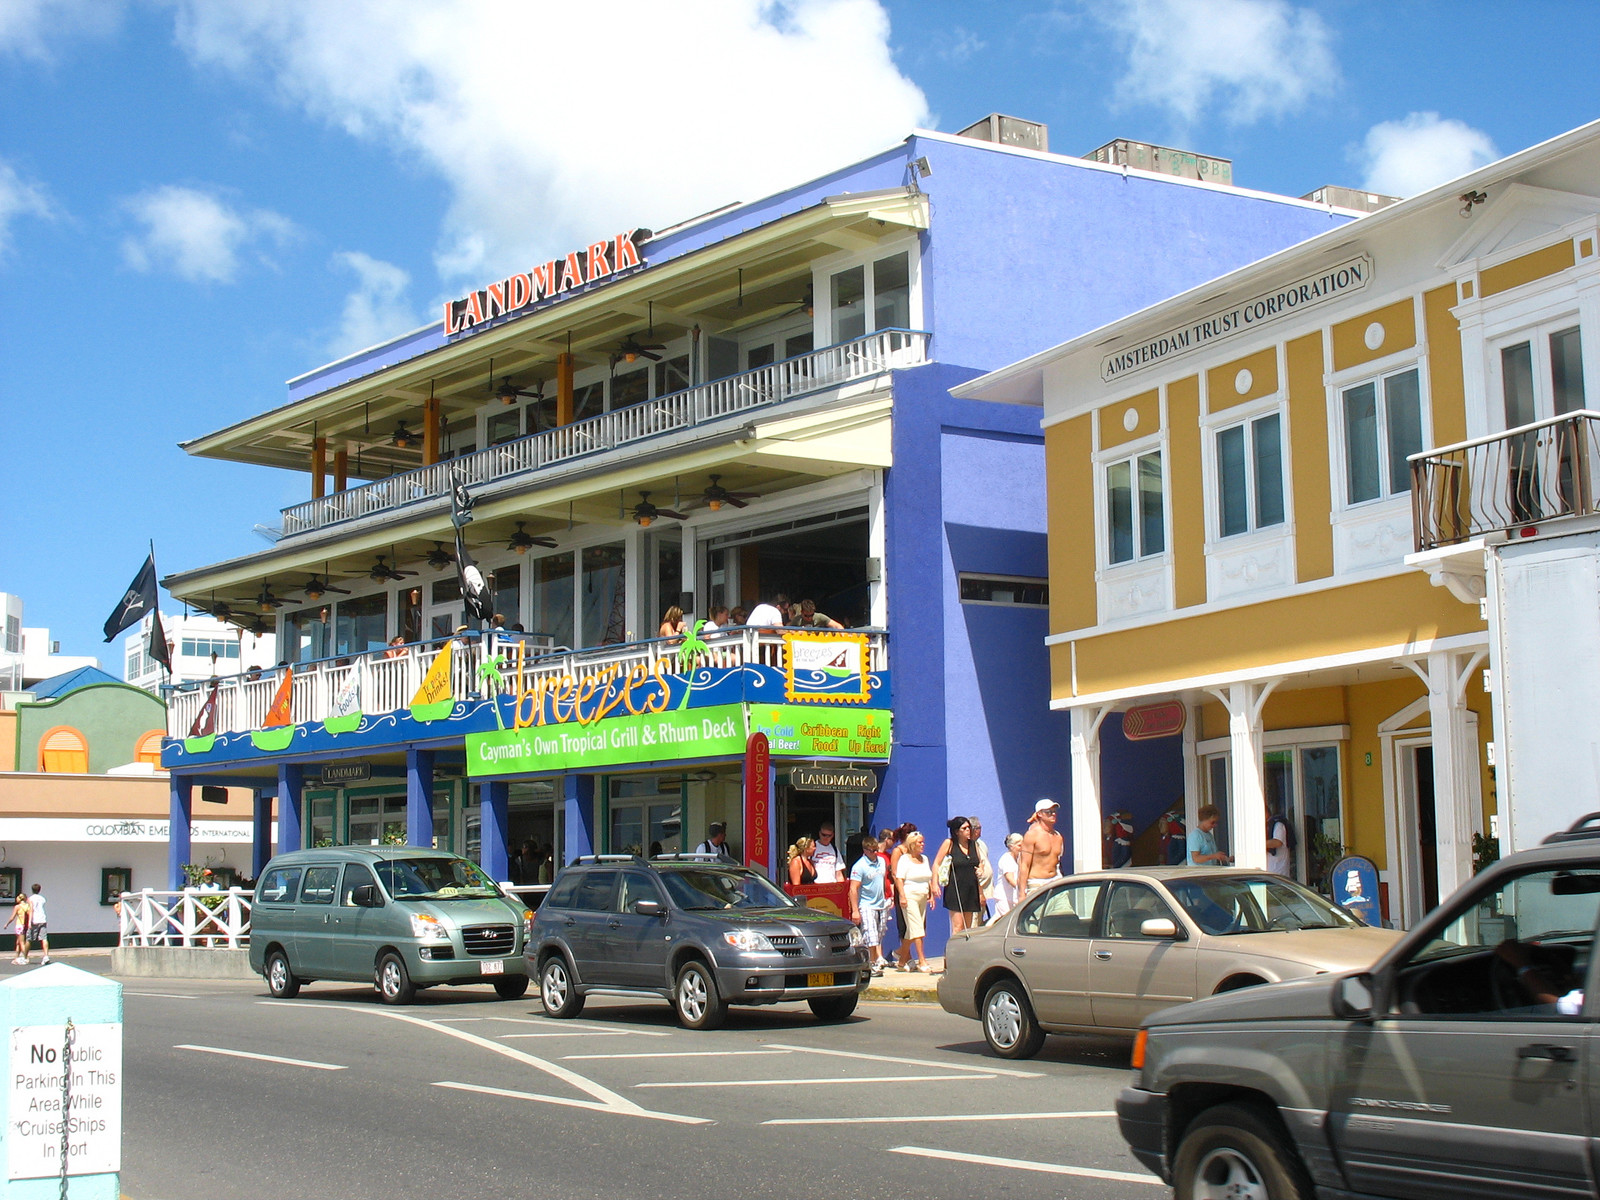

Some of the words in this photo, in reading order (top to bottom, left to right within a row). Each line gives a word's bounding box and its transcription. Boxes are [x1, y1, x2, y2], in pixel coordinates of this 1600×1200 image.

[443, 227, 641, 337] LANDMARK
[1106, 330, 1190, 377] AMSTERDAM
[1193, 310, 1240, 342] TRUST
[1244, 264, 1363, 323] CORPORATION
[426, 672, 449, 704] Drinks!
[514, 640, 671, 733] breezes
[774, 724, 794, 737] Cold
[801, 722, 848, 738] Caribbean
[857, 725, 881, 739] Right
[480, 738, 531, 763] Cayman's
[535, 736, 558, 756] Own
[559, 732, 607, 759] Tropical
[611, 727, 638, 748] Grill
[642, 726, 657, 745] &
[659, 722, 698, 743] Rhum
[703, 716, 736, 738] Deck
[778, 738, 800, 750] Beer!
[812, 738, 839, 752] Food!
[849, 740, 860, 754] Up
[864, 741, 887, 754] Here!
[327, 766, 364, 779] LANDMARK
[755, 741, 765, 793] CUBAN
[800, 772, 868, 787] LANDMARK
[86, 824, 146, 836] COLOMBIAN
[148, 825, 200, 837] EMEDS
[202, 829, 250, 838] INTERNATIONAL
[755, 800, 764, 857] CIGARS
[31, 1044, 57, 1064] No
[16, 1073, 67, 1092] Parking
[72, 1072, 84, 1086] In
[88, 1070, 115, 1085] This
[28, 1097, 60, 1112] Area
[66, 1094, 102, 1109] While
[20, 1119, 64, 1136] Cruise
[69, 1116, 106, 1135] Ships
[43, 1143, 55, 1158] In
